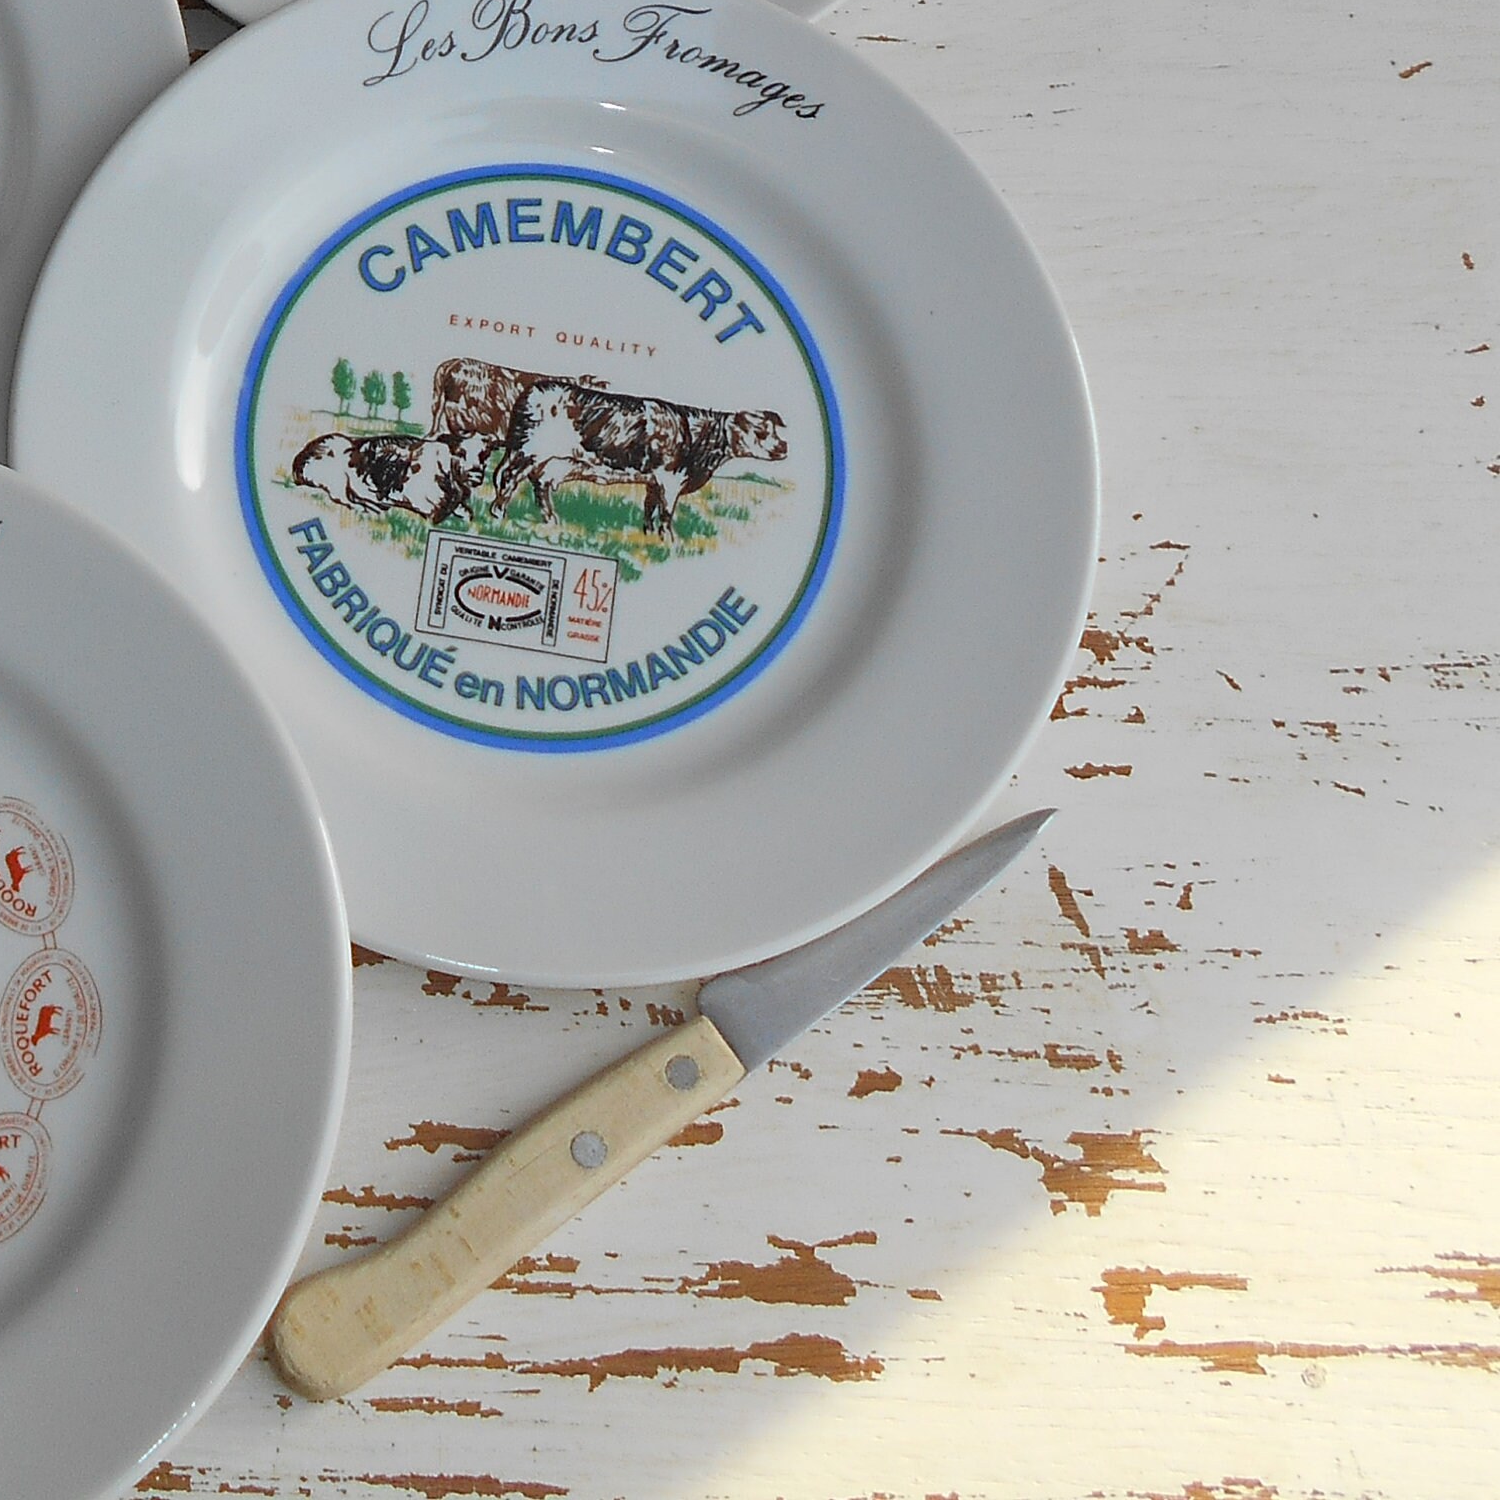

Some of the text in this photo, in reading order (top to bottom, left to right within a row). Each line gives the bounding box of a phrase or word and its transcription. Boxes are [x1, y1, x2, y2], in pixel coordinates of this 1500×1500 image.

[363, 0, 456, 86] Les
[593, 4, 825, 118] Fromages
[358, 198, 765, 346] CAMEMBERT
[449, 314, 657, 356] EXPORT QUALITY
[454, 546, 553, 567] VERITABLE CAMEMBERT
[459, 565, 489, 577] ORIGINE
[435, 564, 449, 615] SYNDICAT DU
[467, 584, 530, 608] NORMANDIE
[573, 568, 612, 613] 45%
[288, 516, 758, 711] FABRIQUÉ en NORMANDIE
[567, 631, 599, 642] GRASSE
[16, 969, 54, 1077] ROQUEFORT
